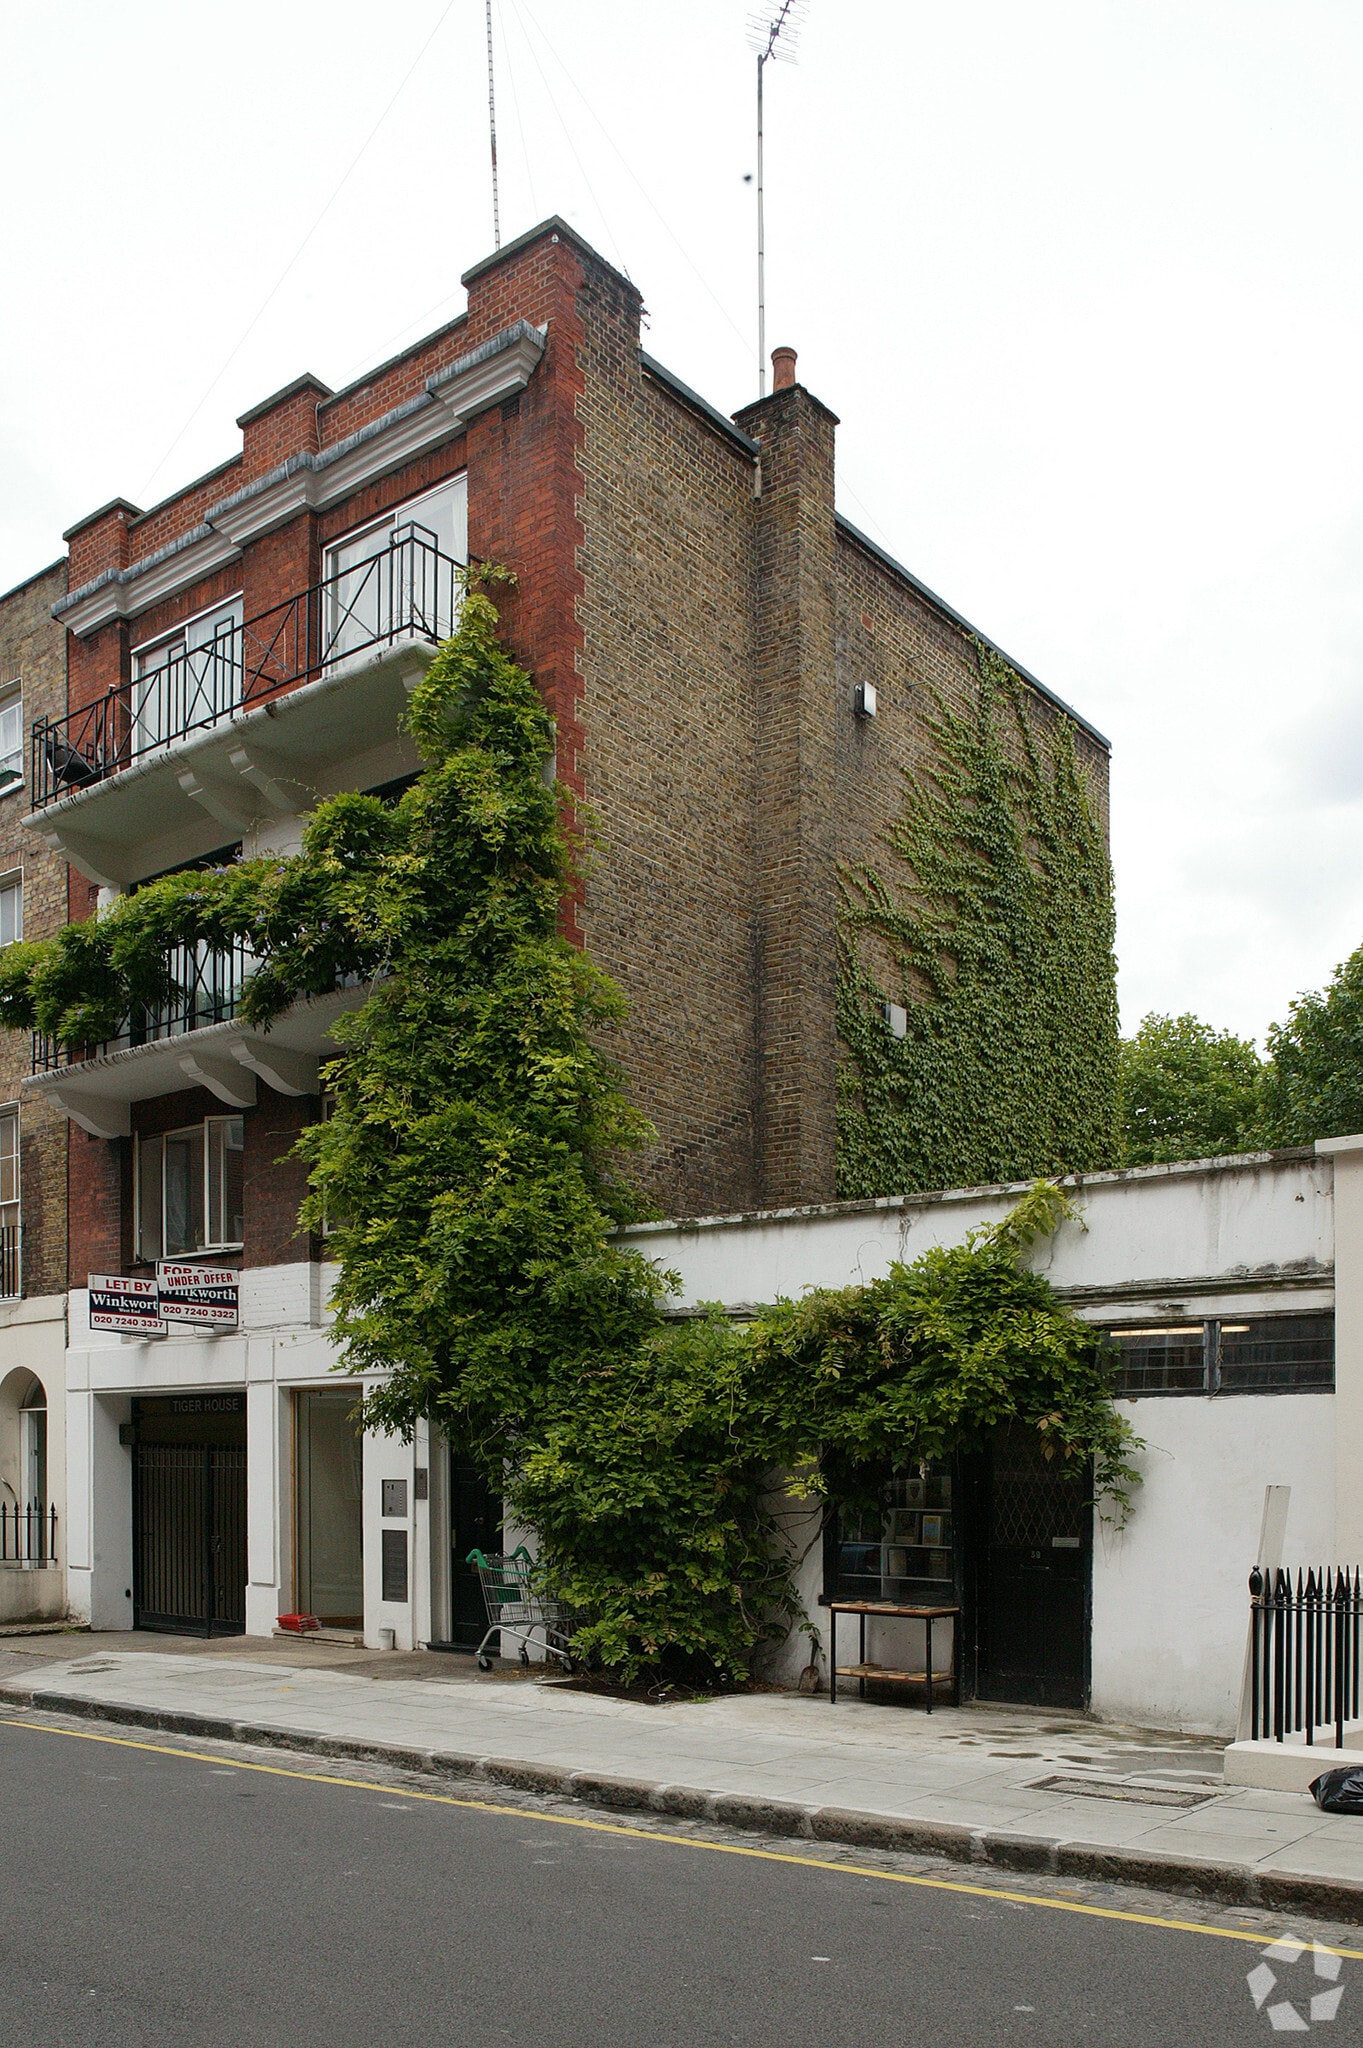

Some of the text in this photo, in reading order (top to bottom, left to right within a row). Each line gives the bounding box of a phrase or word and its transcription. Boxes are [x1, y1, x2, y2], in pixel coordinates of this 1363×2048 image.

[106, 1279, 152, 1292] LET BY
[167, 1273, 233, 1287] UNDER OFFER
[91, 1293, 158, 1311] Winkwort
[163, 1305, 181, 1314] 020
[184, 1307, 208, 1316] 7240
[211, 1310, 235, 1319] 3322
[115, 1317, 138, 1326] 7240
[141, 1320, 164, 1328] 3337
[172, 1398, 239, 1412] TIGER HOUSE
